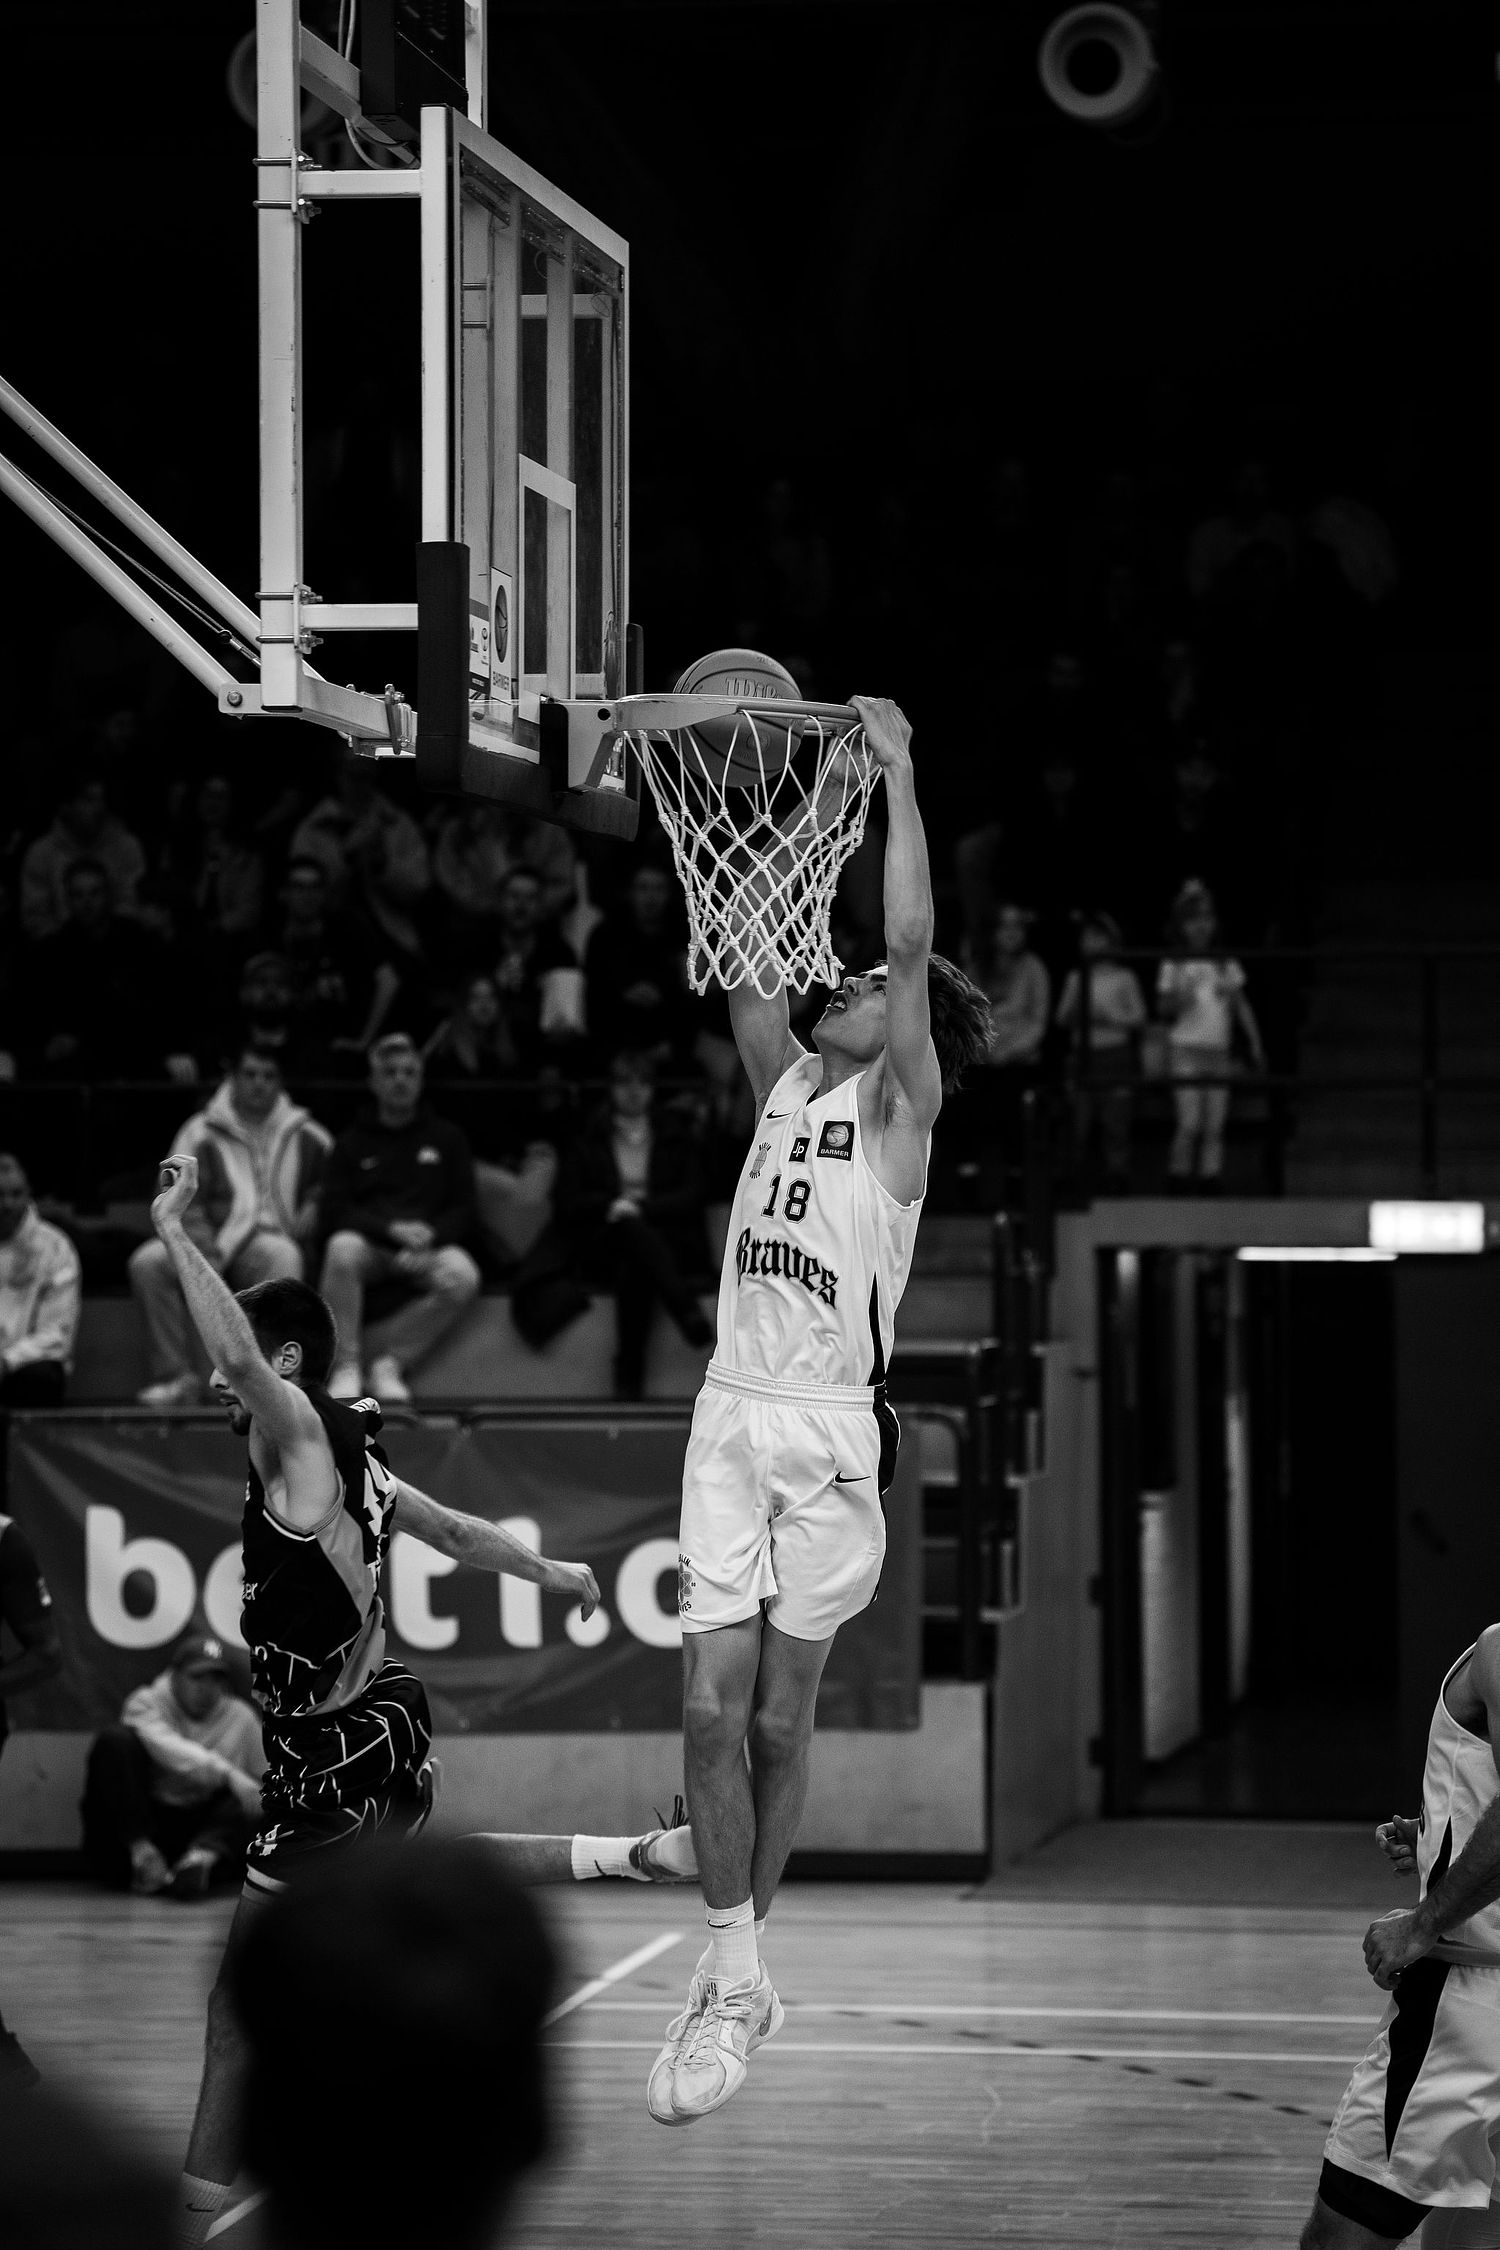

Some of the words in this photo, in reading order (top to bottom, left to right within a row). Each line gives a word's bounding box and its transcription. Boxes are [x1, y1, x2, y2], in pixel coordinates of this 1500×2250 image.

[820, 1148, 849, 1157] BARMER
[761, 1173, 812, 1224] 18
[736, 1227, 839, 1310] Braves
